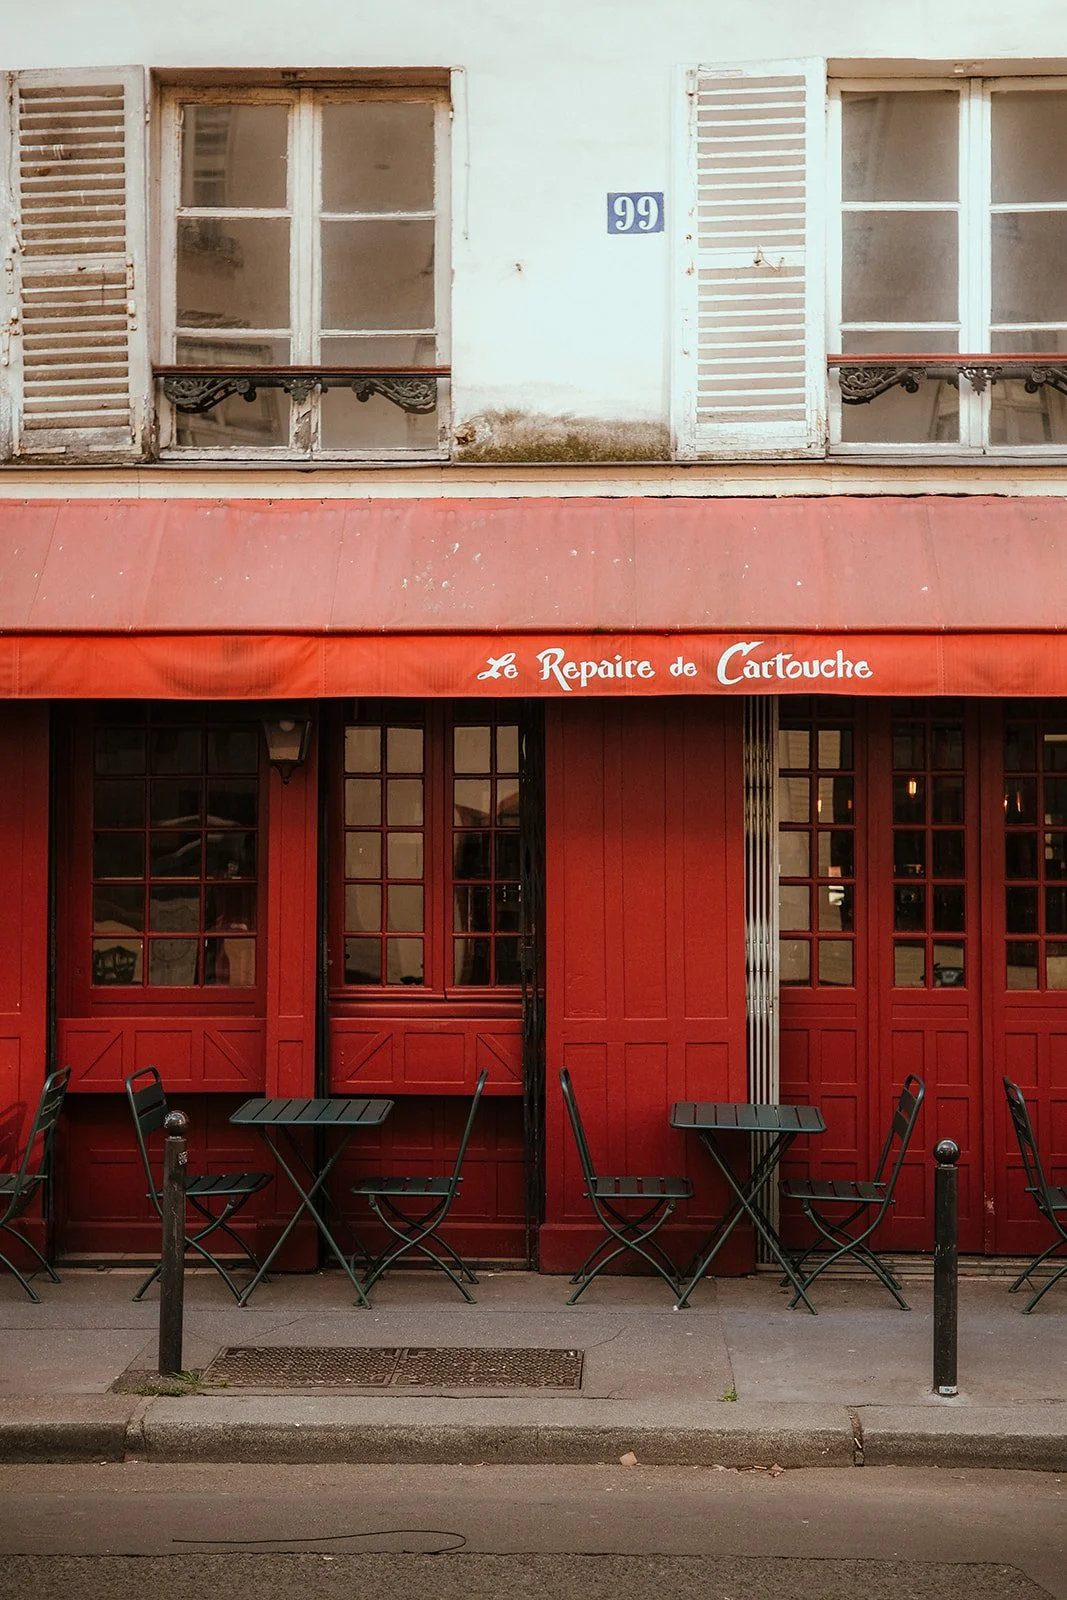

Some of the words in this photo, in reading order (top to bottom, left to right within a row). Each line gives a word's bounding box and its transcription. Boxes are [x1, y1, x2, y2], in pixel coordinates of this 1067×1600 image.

[613, 196, 659, 231] 99
[477, 652, 519, 680] Le
[536, 647, 656, 692] Repaire
[669, 656, 698, 678] de
[716, 641, 873, 686] Cartouche
